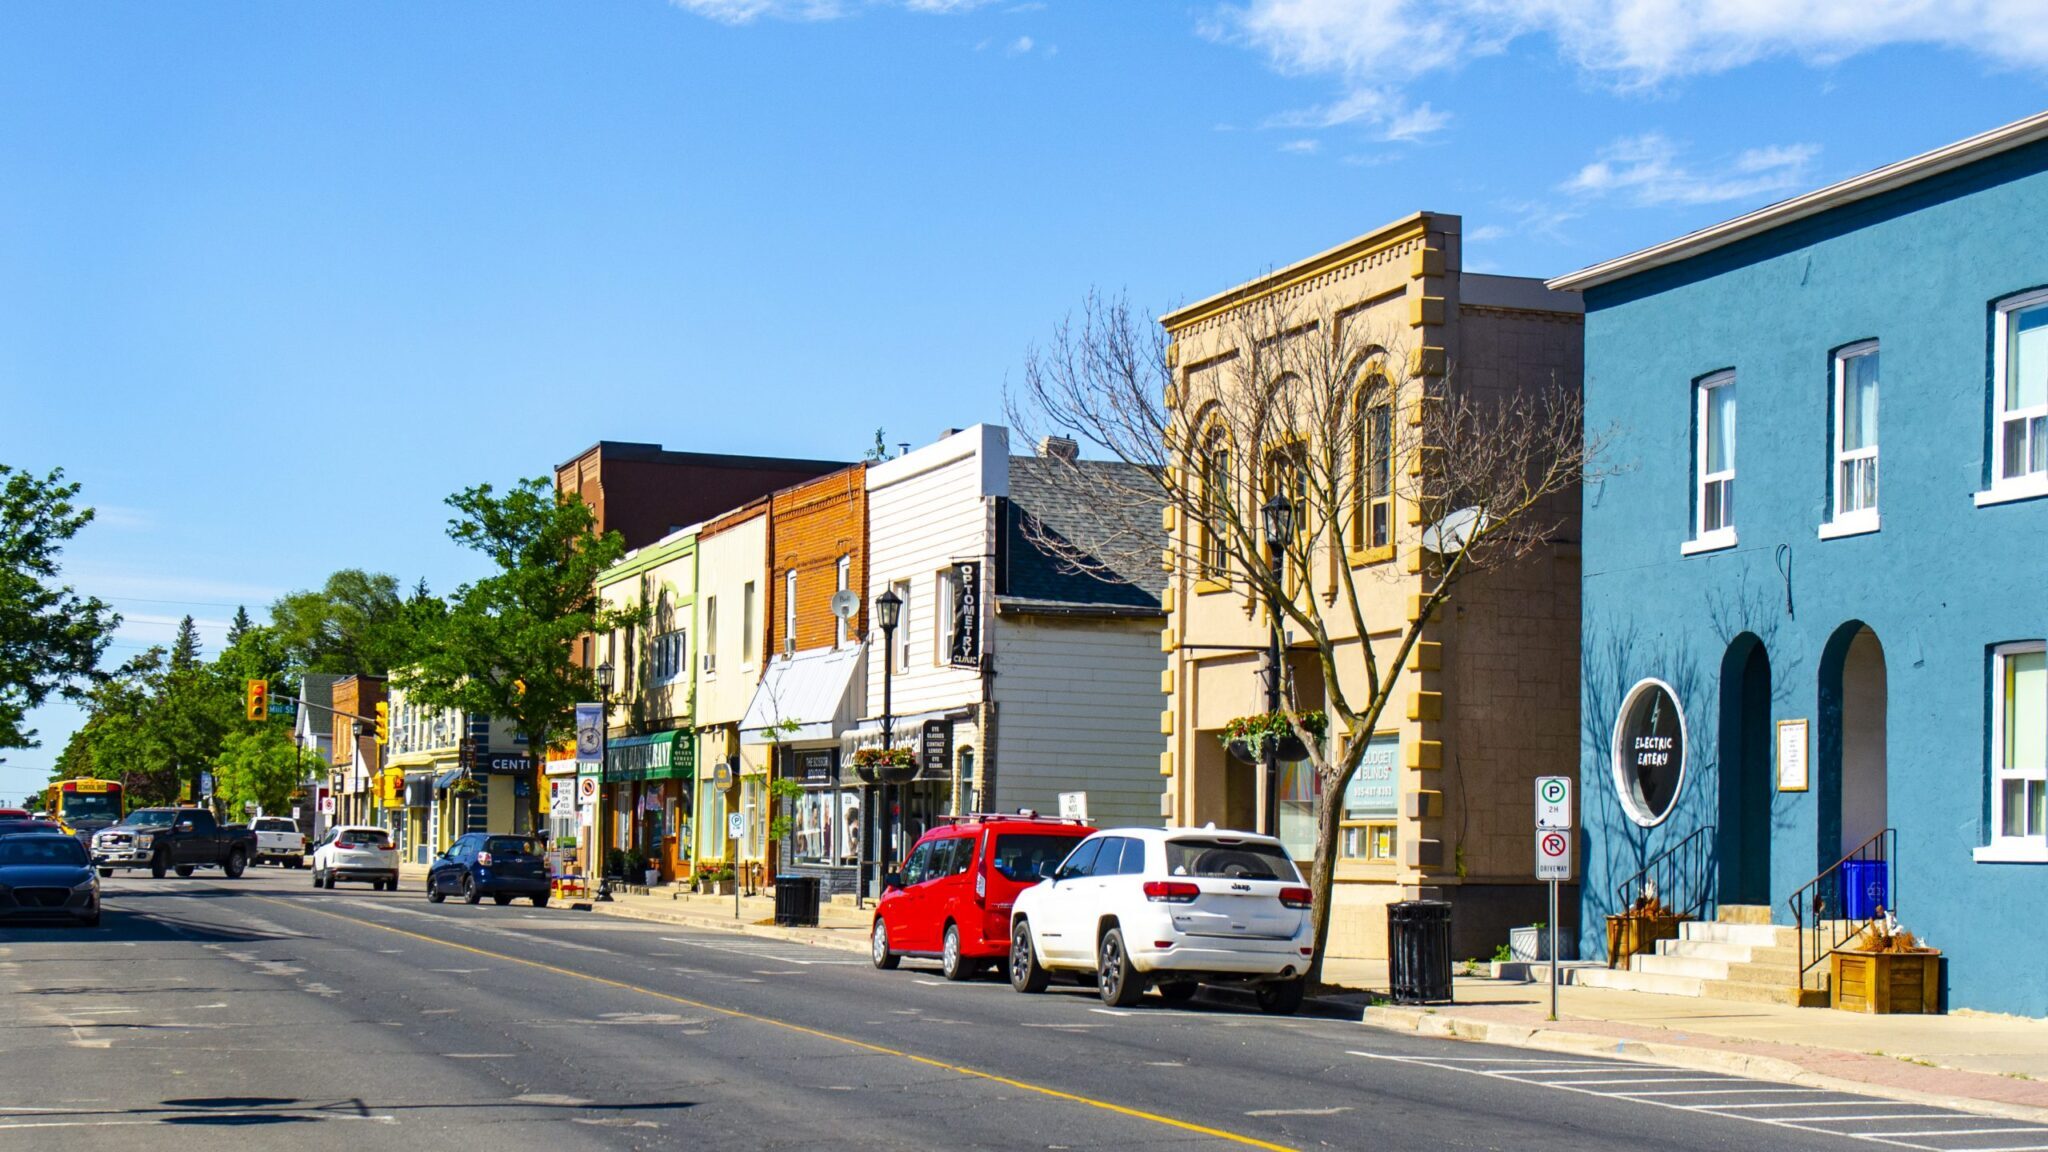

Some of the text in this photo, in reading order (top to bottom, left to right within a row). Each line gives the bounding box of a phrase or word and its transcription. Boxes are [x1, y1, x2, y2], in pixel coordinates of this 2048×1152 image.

[961, 564, 974, 655] OPTOMETRY
[954, 654, 976, 664] CLINIC
[679, 736, 690, 749] 5
[1635, 736, 1672, 750] ELECTRIC
[1638, 752, 1668, 766] EATERY
[1363, 767, 1390, 780] BLINDS
[1231, 883, 1251, 891] Jeep
